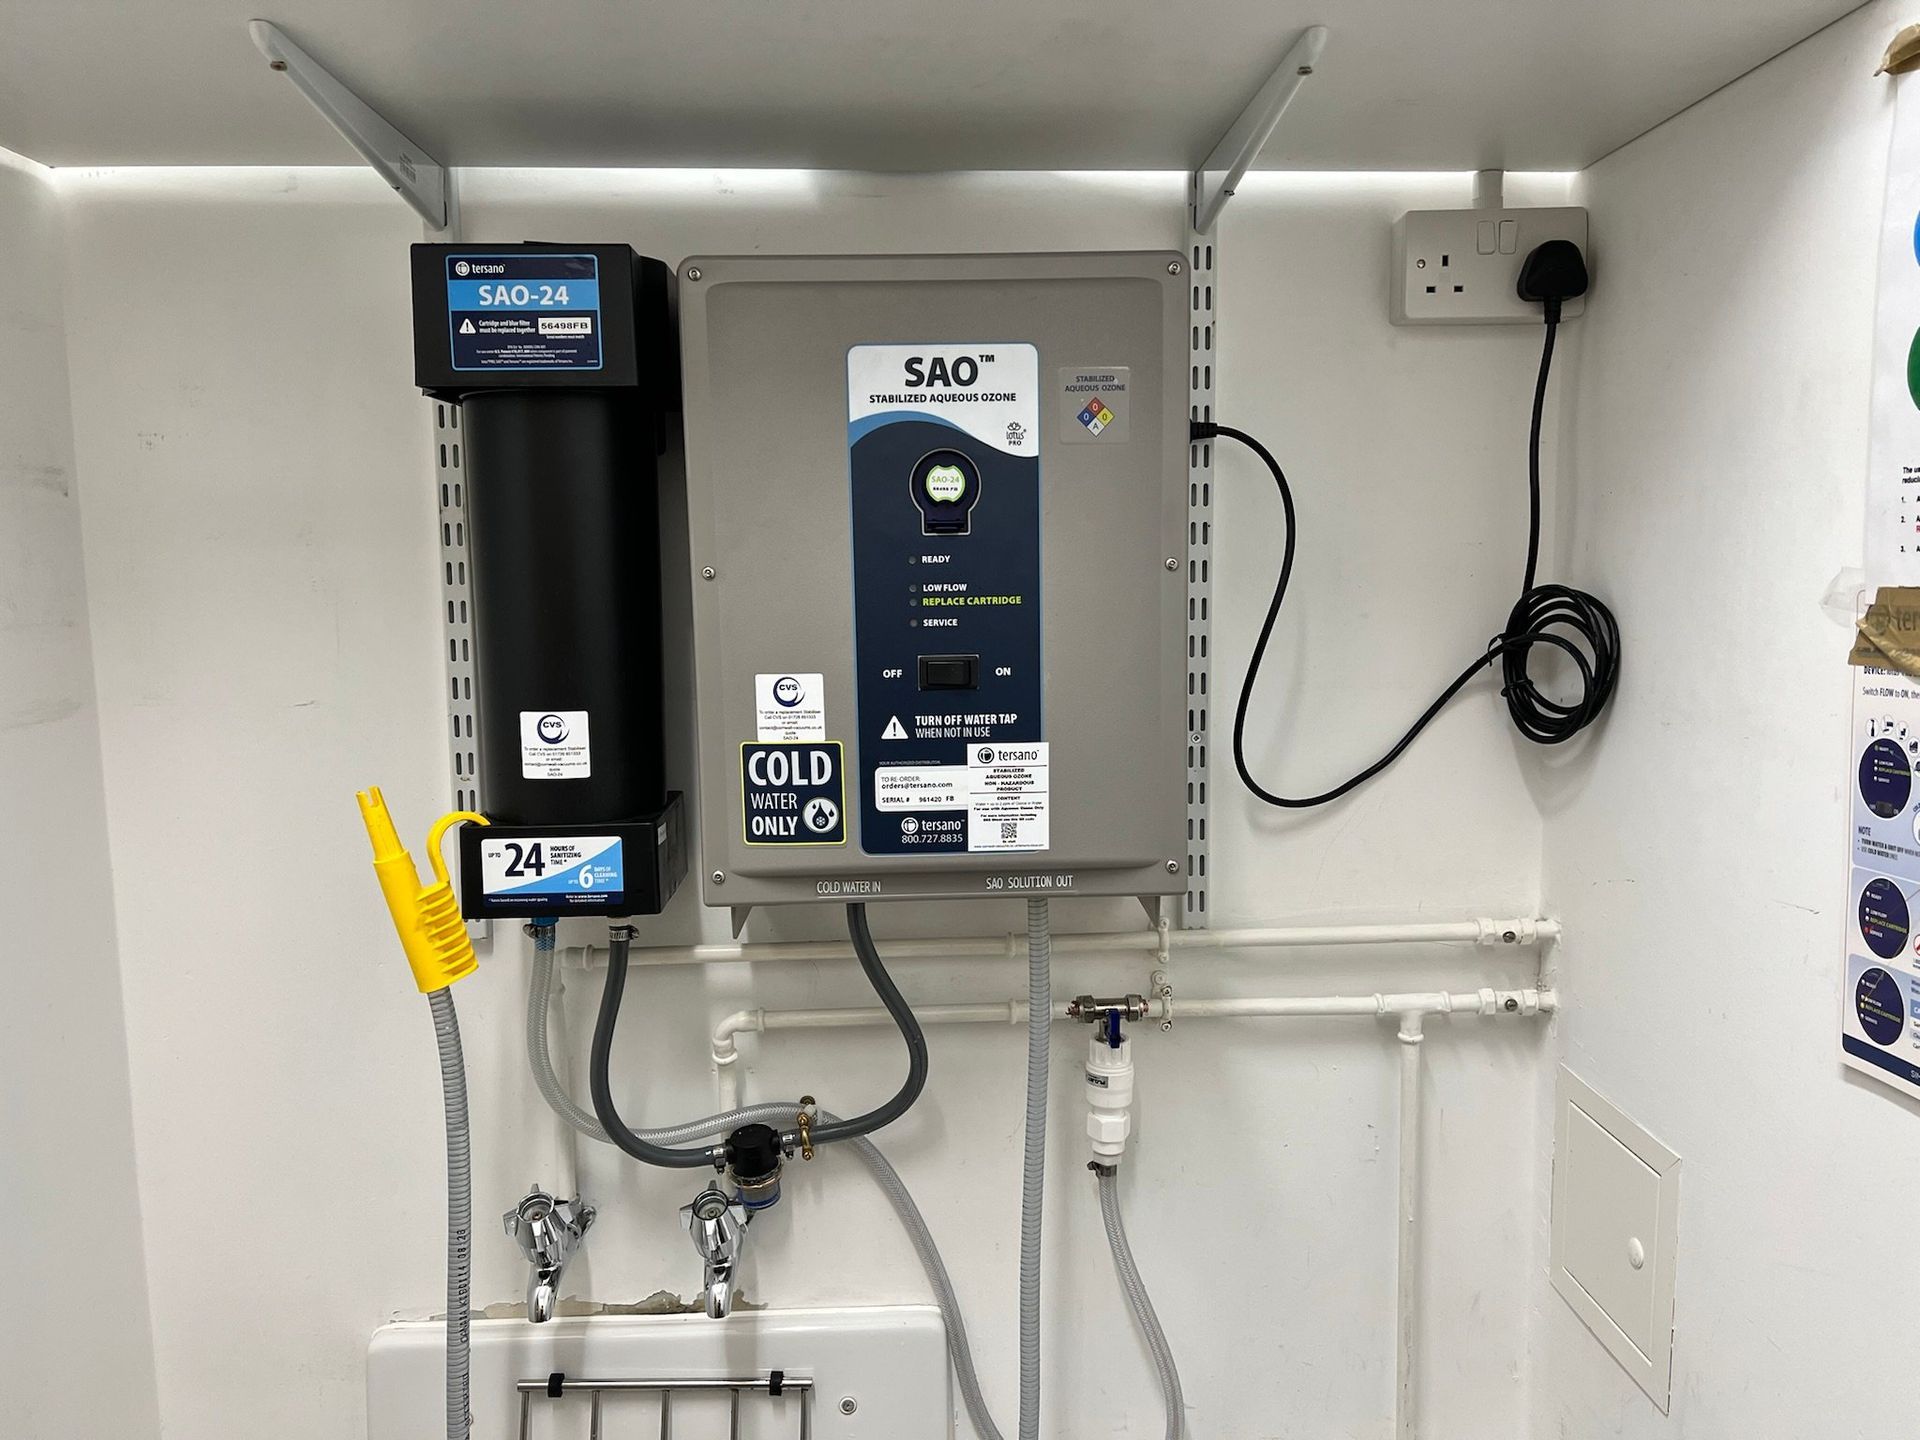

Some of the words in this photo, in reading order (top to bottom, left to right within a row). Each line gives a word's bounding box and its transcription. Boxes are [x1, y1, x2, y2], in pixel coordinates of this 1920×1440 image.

[472, 263, 505, 274] tersano
[478, 285, 569, 306] SAO-24
[541, 322, 588, 330] 56498FB
[1075, 375, 1115, 383] STABILIZED
[1064, 384, 1099, 392] AQUEOUS
[869, 394, 927, 404] STABILIZED
[929, 393, 979, 403] AQUEOUS
[981, 392, 1016, 402] OZONE
[1092, 402, 1099, 411] 0
[1083, 412, 1089, 421] 0
[1102, 413, 1108, 421] 0
[931, 476, 960, 484] SAO-24
[921, 555, 951, 563] READY
[923, 584, 943, 592] LOW
[943, 583, 967, 592] FLOW
[922, 597, 965, 606] REPLACE
[967, 596, 1022, 605] CARTRIDGE
[923, 618, 958, 627] SERVICE
[882, 669, 903, 678] OFF
[995, 667, 1012, 676] ON
[1862, 686, 1879, 696] Switch
[1879, 687, 1894, 697] FLOW
[915, 715, 942, 726] TURN
[944, 715, 963, 725] OFF
[964, 714, 997, 725] WATER
[998, 713, 1018, 724] TAP
[915, 728, 943, 739] WHEN
[943, 727, 962, 738] NOT
[963, 727, 973, 737] IN
[974, 726, 991, 737] USE
[998, 750, 1038, 761] tersano
[748, 750, 832, 786] COLD
[750, 792, 798, 810] WATER
[751, 815, 798, 836] ONLY
[921, 819, 961, 831] tersano
[1858, 825, 1871, 836] NOTE
[901, 834, 963, 844] 800.727.8835
[504, 842, 546, 877] 24
[578, 864, 594, 889] 6
[986, 877, 1003, 889] SAO
[1007, 875, 1052, 888] SOLUTION
[1056, 875, 1073, 887] OUT
[816, 881, 840, 893] COLD
[842, 881, 870, 893] WATER
[872, 880, 881, 892] IN
